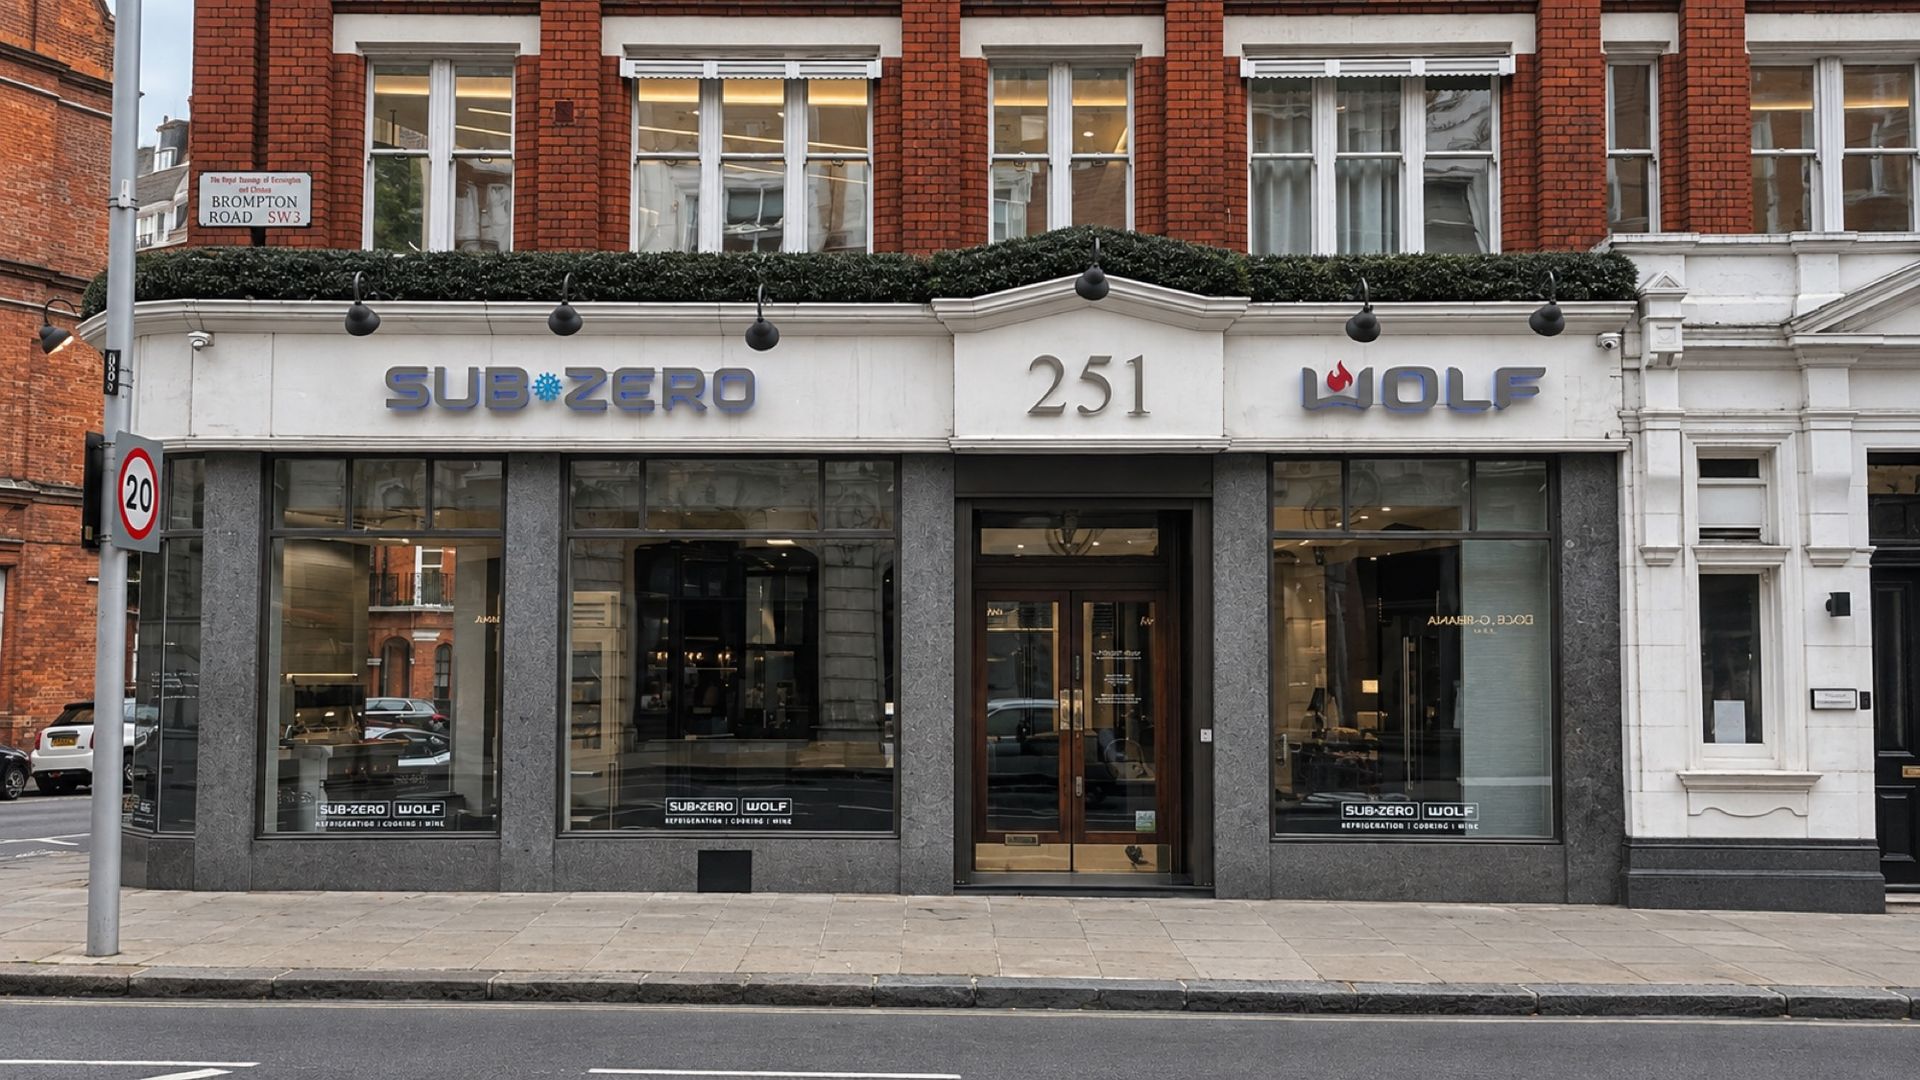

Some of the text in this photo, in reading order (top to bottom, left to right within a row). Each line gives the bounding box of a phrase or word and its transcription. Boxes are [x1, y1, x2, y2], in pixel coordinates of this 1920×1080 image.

[212, 195, 297, 208] BROMPTON
[209, 211, 301, 224] ROAD SW3
[1027, 354, 1151, 415] 251
[1300, 366, 1547, 412] WOLF
[126, 474, 152, 513] 20
[398, 804, 441, 815] WOLF
[746, 801, 788, 812] WOLF
[1428, 806, 1474, 816] WOLF
